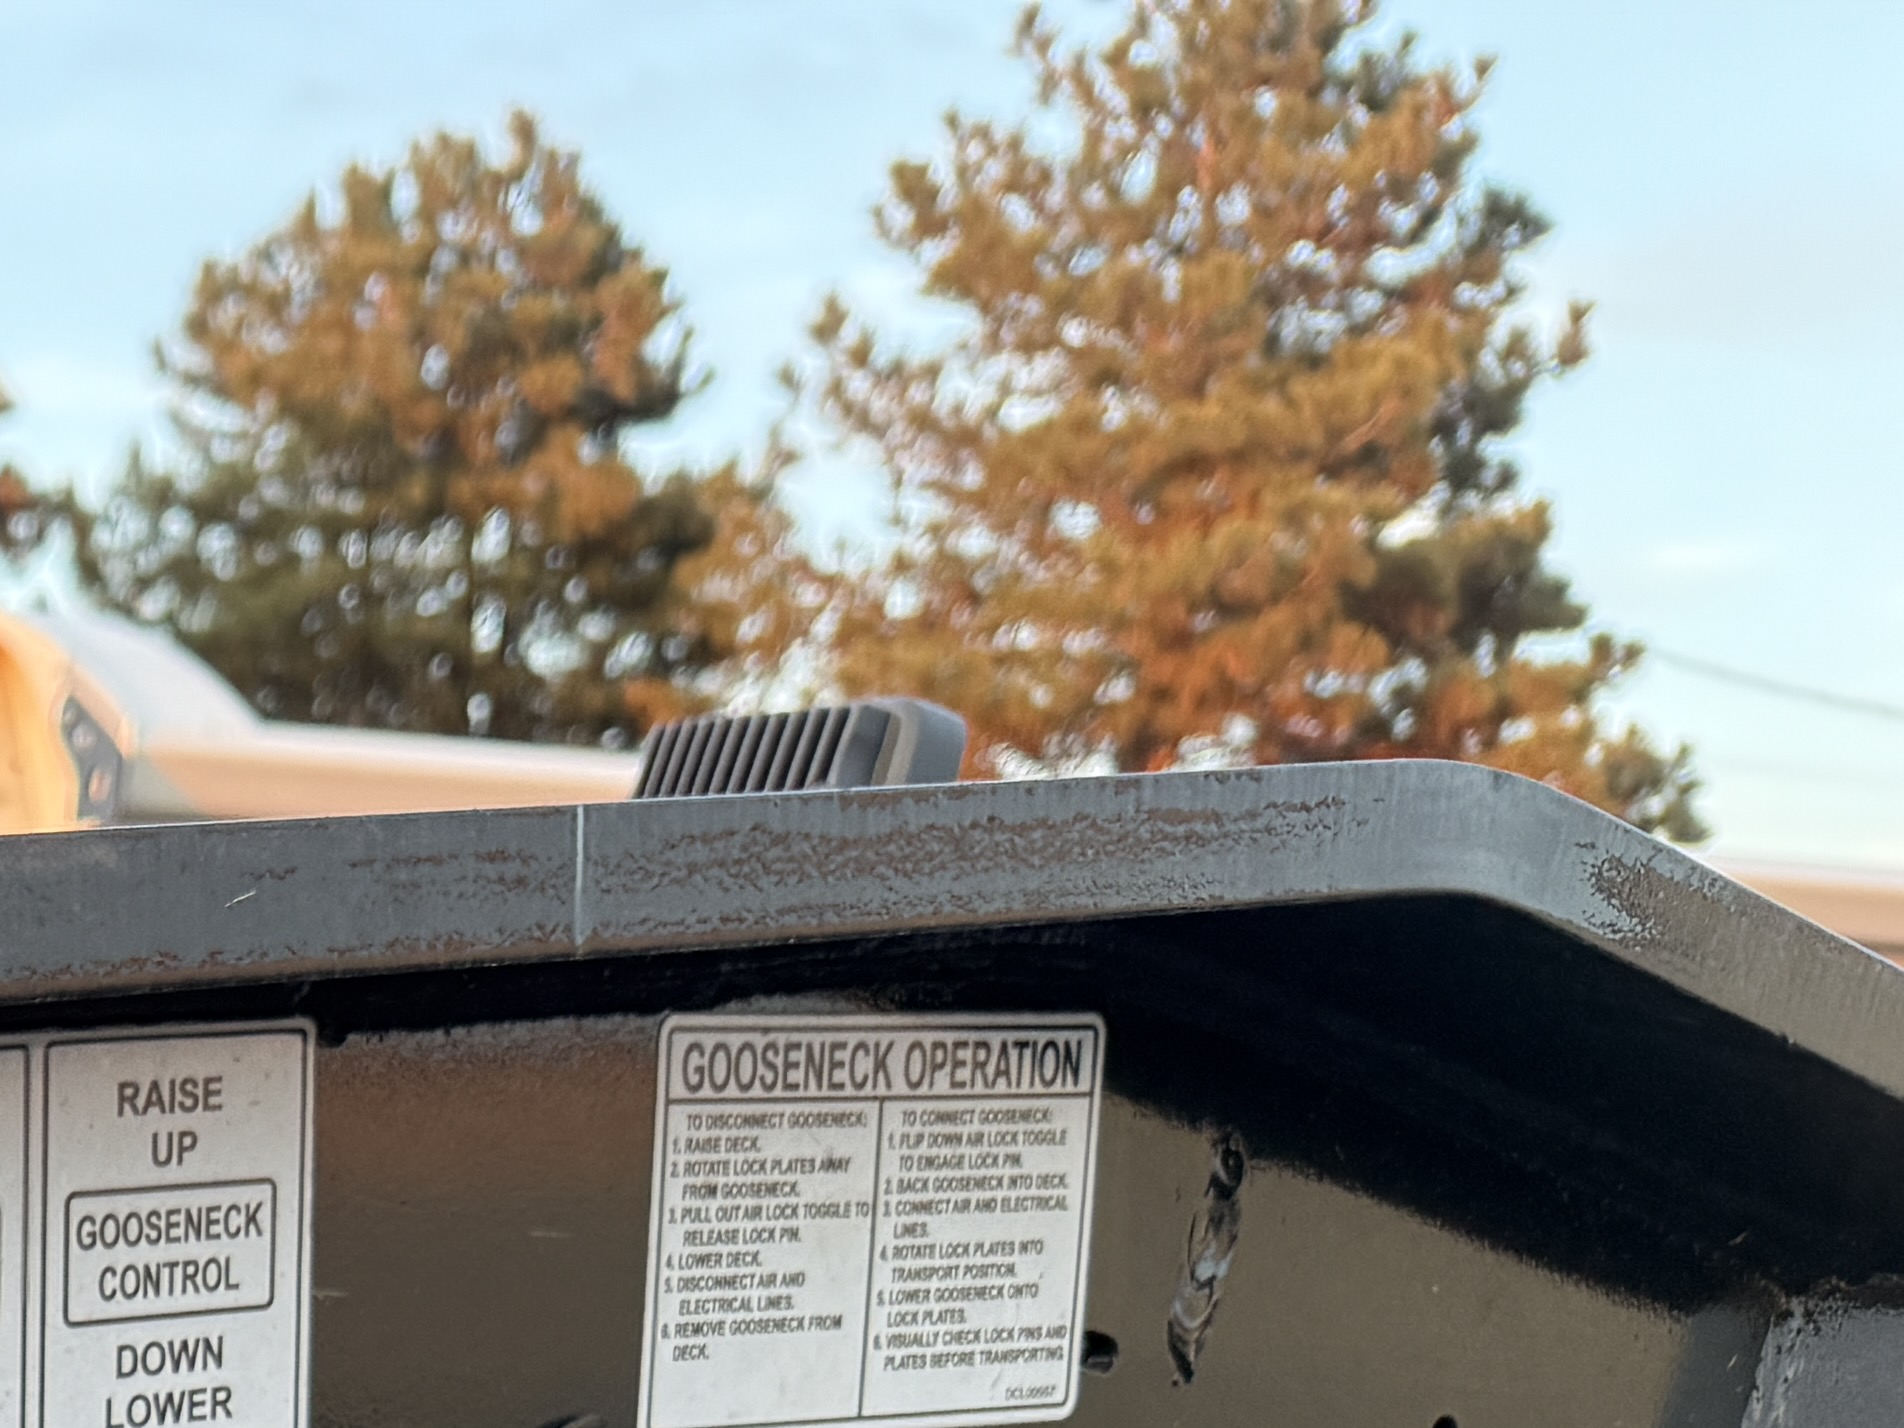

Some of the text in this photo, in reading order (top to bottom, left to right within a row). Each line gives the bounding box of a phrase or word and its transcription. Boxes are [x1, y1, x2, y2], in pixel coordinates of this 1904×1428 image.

[682, 1039, 1082, 1093] GOOSENECK OPERATION
[116, 1076, 224, 1117] RAISE
[686, 1115, 702, 1131] TO
[706, 1113, 785, 1130] DISCONNECT
[902, 1112, 916, 1127] TO
[920, 1110, 975, 1126] CONNECT
[684, 1137, 721, 1154] RAISE
[725, 1136, 761, 1153] DECK.
[899, 1133, 925, 1149] FLIP
[927, 1132, 963, 1148] DOWN
[965, 1131, 984, 1146] AIR
[987, 1130, 1020, 1146] LOCK
[1022, 1128, 1067, 1145] TOGGLE
[151, 1131, 198, 1167] UP
[683, 1160, 730, 1177] ROTATE
[733, 1159, 767, 1175] LOCK
[770, 1158, 815, 1175] PLATES
[817, 1157, 851, 1173] AWAY
[899, 1156, 913, 1172] TO
[917, 1154, 965, 1171] ENGAGE
[968, 1153, 999, 1170] LOCK
[682, 1184, 718, 1200] FROM
[896, 1177, 930, 1194] BACK
[932, 1175, 1004, 1192] GOOSENECK
[1007, 1174, 1032, 1190] INTO
[680, 1207, 712, 1224] PULL
[715, 1206, 741, 1222] OUT
[742, 1205, 763, 1221] AIR
[766, 1204, 799, 1220] LOCK
[803, 1203, 851, 1219] TOGGLE
[855, 1202, 869, 1218] TO
[895, 1200, 951, 1216] CONNECT
[951, 1199, 971, 1215] AIR
[973, 1198, 997, 1214] AND
[1000, 1195, 1068, 1212] ELECTRICAL
[76, 1201, 264, 1252] GOOSENECK
[683, 1230, 739, 1247] RELEASE
[742, 1229, 776, 1245] LOCK
[892, 1243, 936, 1261] ROTATE
[939, 1241, 971, 1259] LOCK
[973, 1240, 1015, 1256] PLATES
[1018, 1239, 1043, 1255] INTO
[678, 1252, 722, 1270] LOWER
[726, 1251, 762, 1268] DECK.
[98, 1257, 240, 1302] CONTROL
[677, 1275, 756, 1293] DISCONNECT
[757, 1274, 776, 1288] AIR
[779, 1272, 806, 1287] AND
[892, 1265, 961, 1283] TRANSPORT
[889, 1288, 931, 1305] LOWER
[934, 1285, 1005, 1303] GOOSENECK
[1008, 1283, 1039, 1299] ONTO
[679, 1297, 754, 1315] ELECTRICAL
[674, 1321, 725, 1339] REMOVE
[729, 1317, 805, 1335] GOOSENECK
[807, 1315, 842, 1331] FROM
[887, 1311, 919, 1328] LOCK
[886, 1332, 940, 1349] VISUALLY
[942, 1329, 981, 1346] CHECK
[985, 1327, 1015, 1344] LOCK
[1045, 1325, 1067, 1339] AND
[115, 1336, 224, 1380] DOWN
[672, 1345, 709, 1361] DECK.
[884, 1354, 927, 1371] PLATES
[930, 1352, 975, 1368] BEFORE
